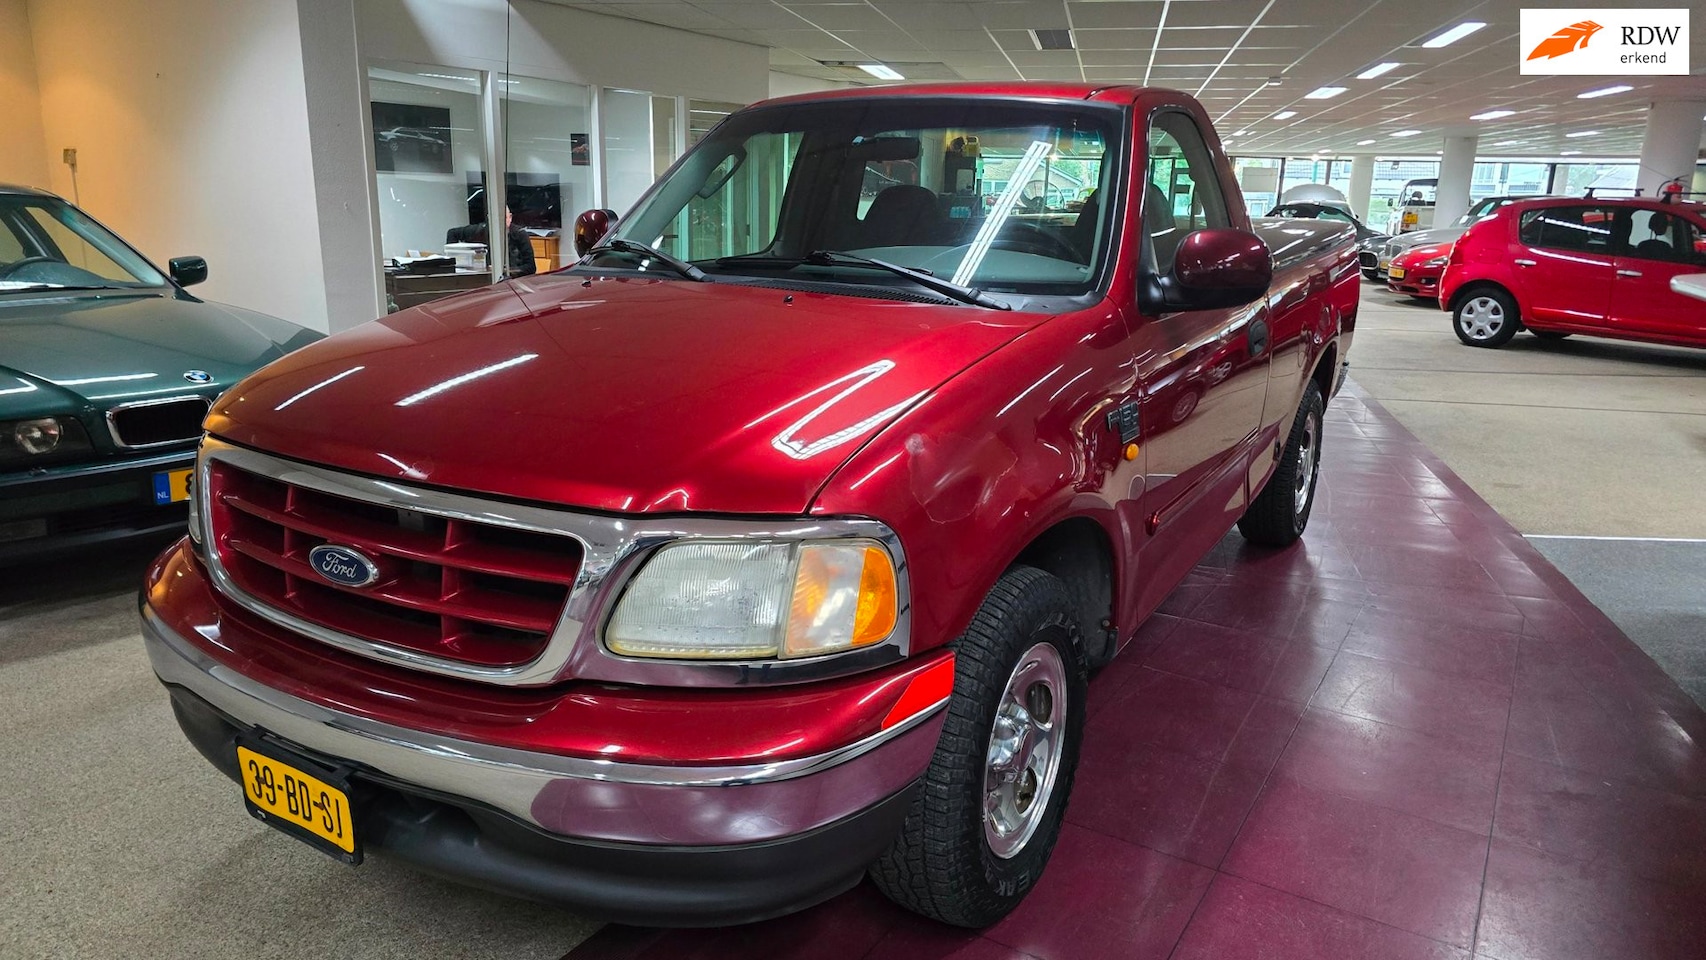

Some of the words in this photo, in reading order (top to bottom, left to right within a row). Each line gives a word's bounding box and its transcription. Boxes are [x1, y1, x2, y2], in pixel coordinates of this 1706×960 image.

[157, 491, 169, 499] NL
[322, 552, 357, 578] Ford
[249, 760, 342, 839] 39-BD-SJ
